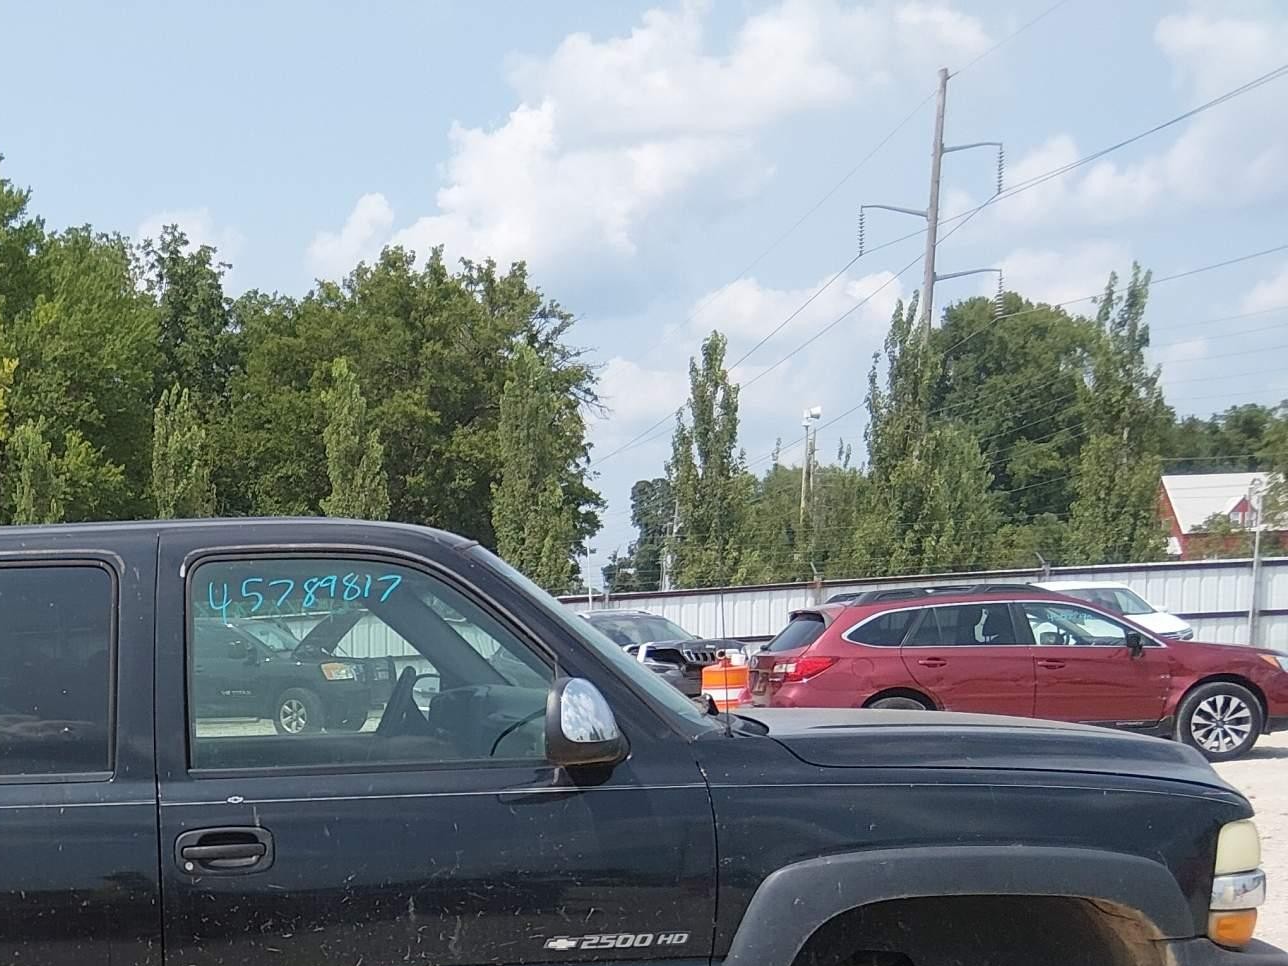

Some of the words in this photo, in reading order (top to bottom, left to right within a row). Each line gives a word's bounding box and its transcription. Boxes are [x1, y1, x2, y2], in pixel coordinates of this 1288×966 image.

[208, 573, 402, 625] 45789817
[580, 933, 654, 949] 2500
[657, 933, 689, 945] HD
